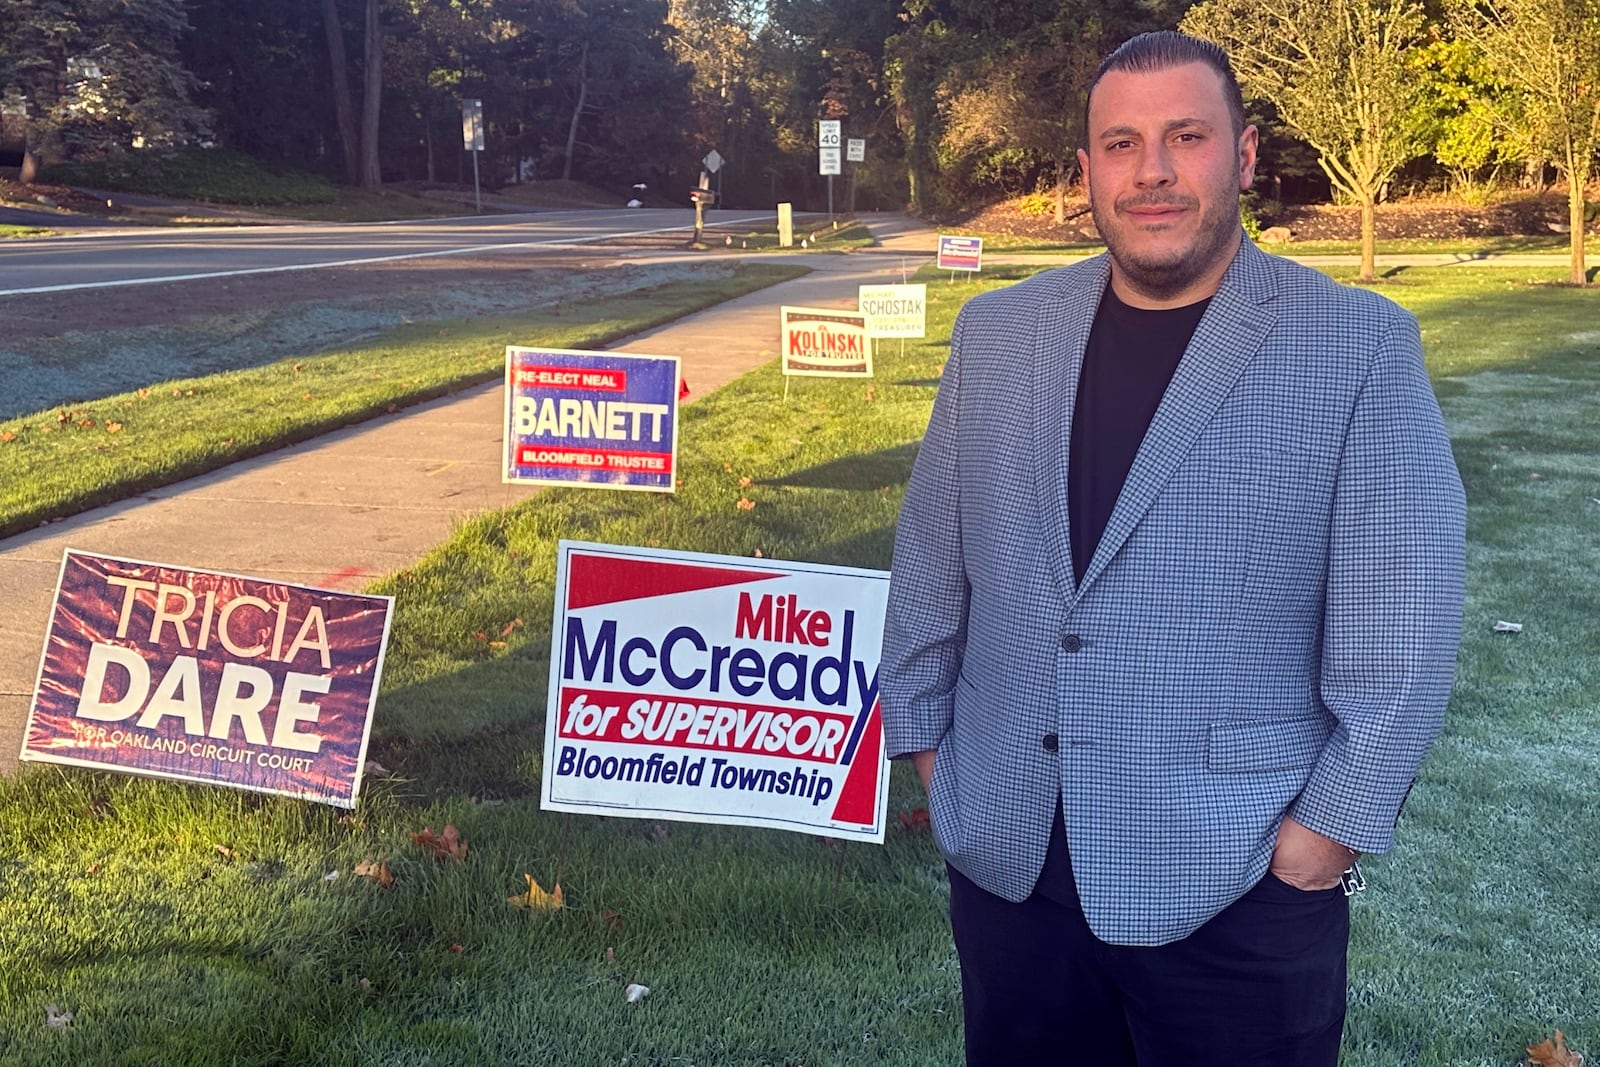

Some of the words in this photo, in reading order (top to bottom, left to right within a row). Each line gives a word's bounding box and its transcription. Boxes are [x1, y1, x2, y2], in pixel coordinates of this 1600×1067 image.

[821, 134, 839, 145] 40
[863, 299, 922, 316] SCHOSTAK
[789, 328, 864, 356] KOLINSKI
[518, 371, 580, 385] RE-ELECT
[582, 375, 616, 387] NEAL
[514, 396, 669, 442] BARNETT
[522, 450, 604, 466] BLOOMFIELD
[607, 455, 665, 470] TRUSTEE
[106, 575, 332, 669] TRICIA
[734, 591, 832, 647] Mike
[75, 641, 332, 754] DARE
[563, 609, 880, 766] McCready
[74, 724, 107, 742] FOR
[110, 730, 187, 755] OAKLAND
[190, 741, 256, 766] CIRCUIT
[257, 753, 314, 773] COURT
[562, 694, 619, 736] for
[621, 700, 846, 760] SUPERVISOR
[556, 746, 706, 788] Bloomfield
[709, 758, 833, 807] Township
